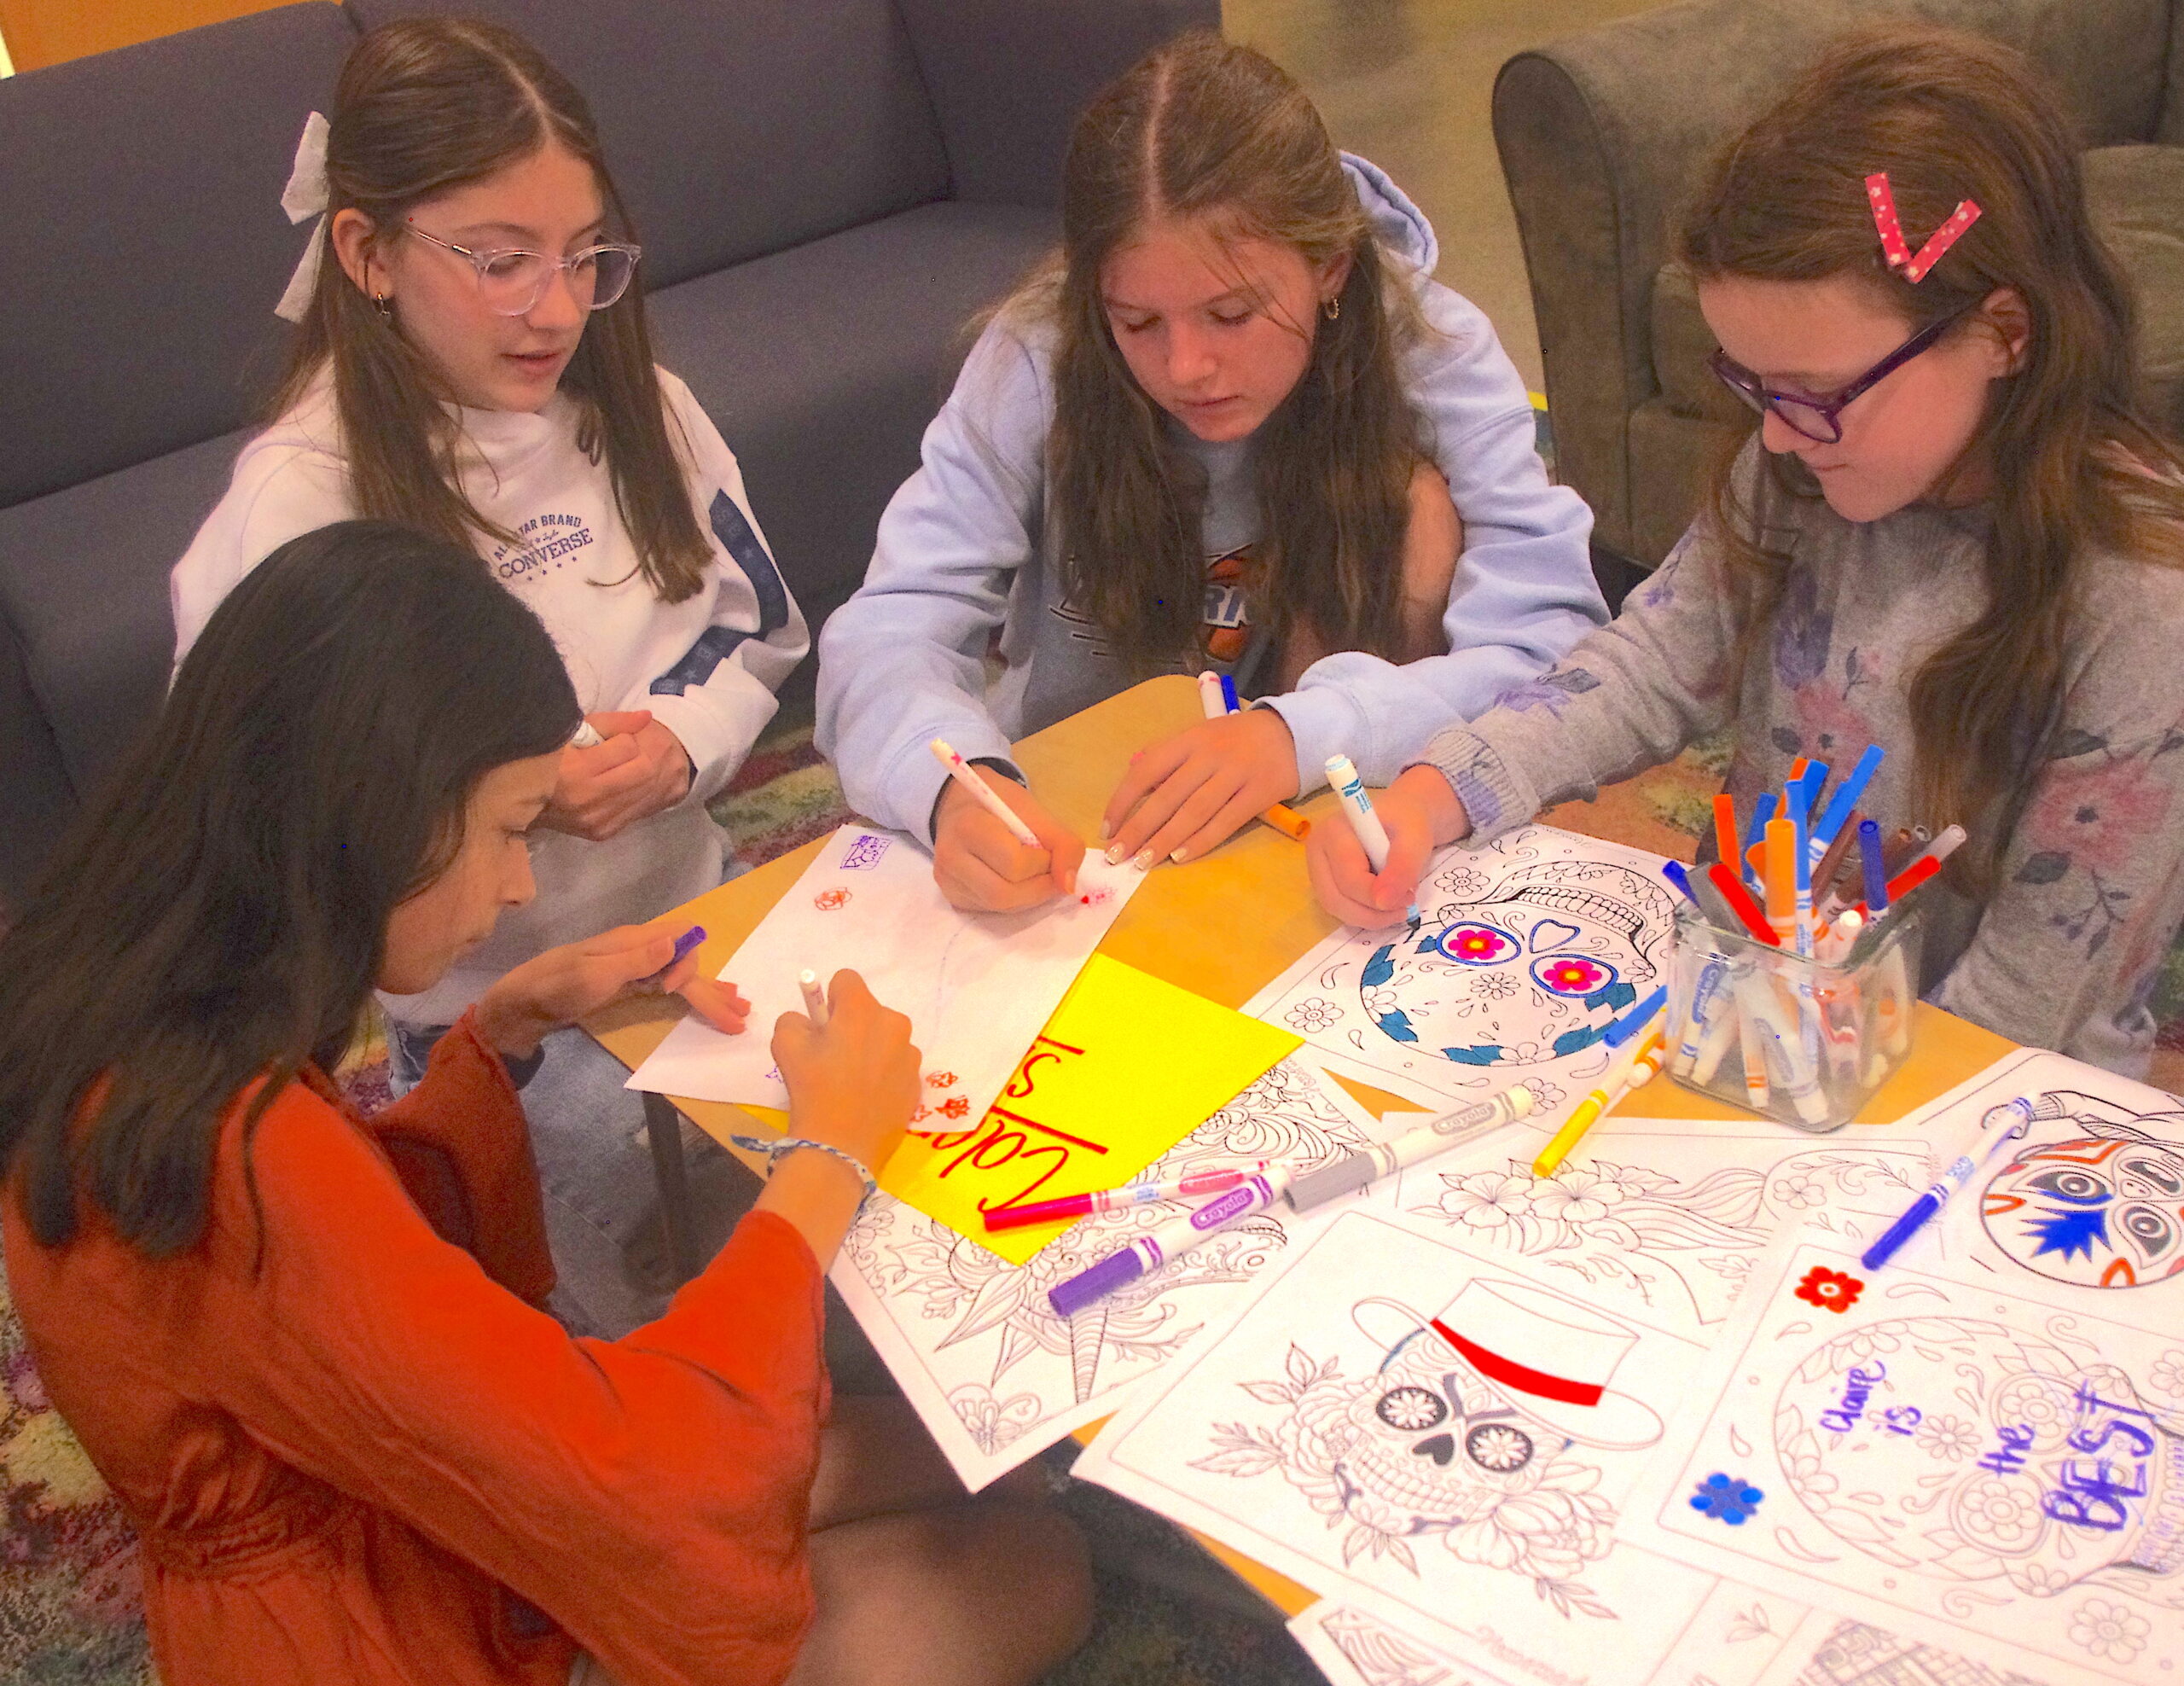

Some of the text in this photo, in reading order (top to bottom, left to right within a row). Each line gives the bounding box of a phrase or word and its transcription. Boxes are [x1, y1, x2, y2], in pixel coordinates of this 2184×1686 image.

[518, 519, 538, 535] TAR
[541, 514, 582, 528] BRAND
[498, 527, 595, 579] CONVERSE
[1437, 1106, 1491, 1131] Crayola
[1196, 1191, 1250, 1225] Crayola
[1818, 1359, 1886, 1433] Claire
[1873, 1405, 1923, 1437] is
[1976, 1423, 2036, 1478] the
[2041, 1378, 2157, 1532] BEST
